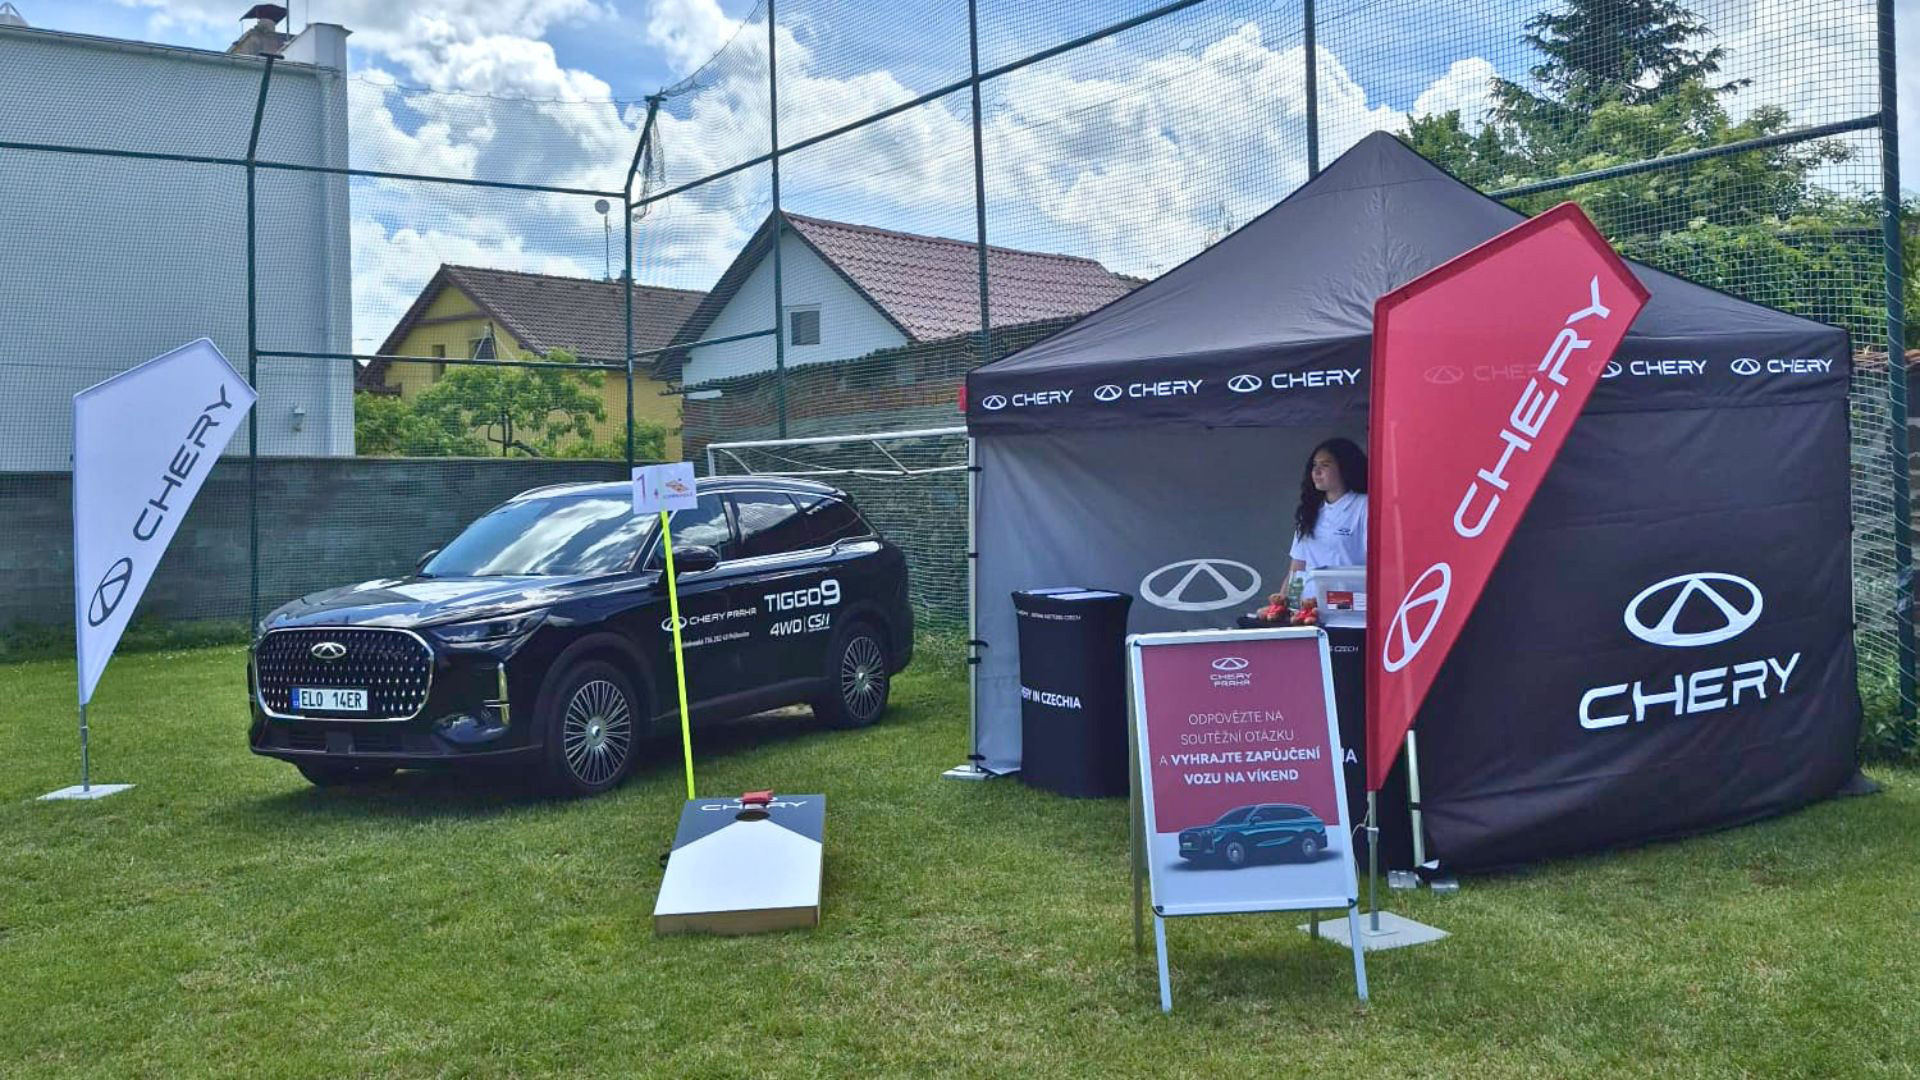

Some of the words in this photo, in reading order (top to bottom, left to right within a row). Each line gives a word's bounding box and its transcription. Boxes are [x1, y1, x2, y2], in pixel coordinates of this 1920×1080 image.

[1629, 359, 1708, 377] CHERY
[1766, 358, 1834, 374] CHERY
[1271, 368, 1362, 389] CHERY
[1012, 389, 1074, 406] CHERY
[1128, 379, 1204, 398] CHERY
[1453, 275, 1611, 538] CHERY
[132, 383, 233, 542] CHERY
[636, 473, 647, 503] 1
[689, 612, 726, 626] CHERY
[769, 618, 803, 637] 4WD
[1210, 673, 1252, 681] CHERY
[1032, 689, 1040, 703] IN
[1041, 691, 1082, 709] CZECHIA
[1579, 652, 1801, 729] CHERY
[332, 692, 362, 709] 14ER
[1188, 709, 1263, 726] ODPOVĚZTE
[1265, 710, 1284, 722] NA
[1159, 755, 1169, 767] A
[1170, 751, 1243, 766] VYHRAJTE
[1245, 745, 1321, 763] ZAPŮJČENÍ
[1184, 772, 1222, 785] VOZU
[1224, 770, 1245, 784] NA
[1248, 767, 1299, 783] VÍKEND
